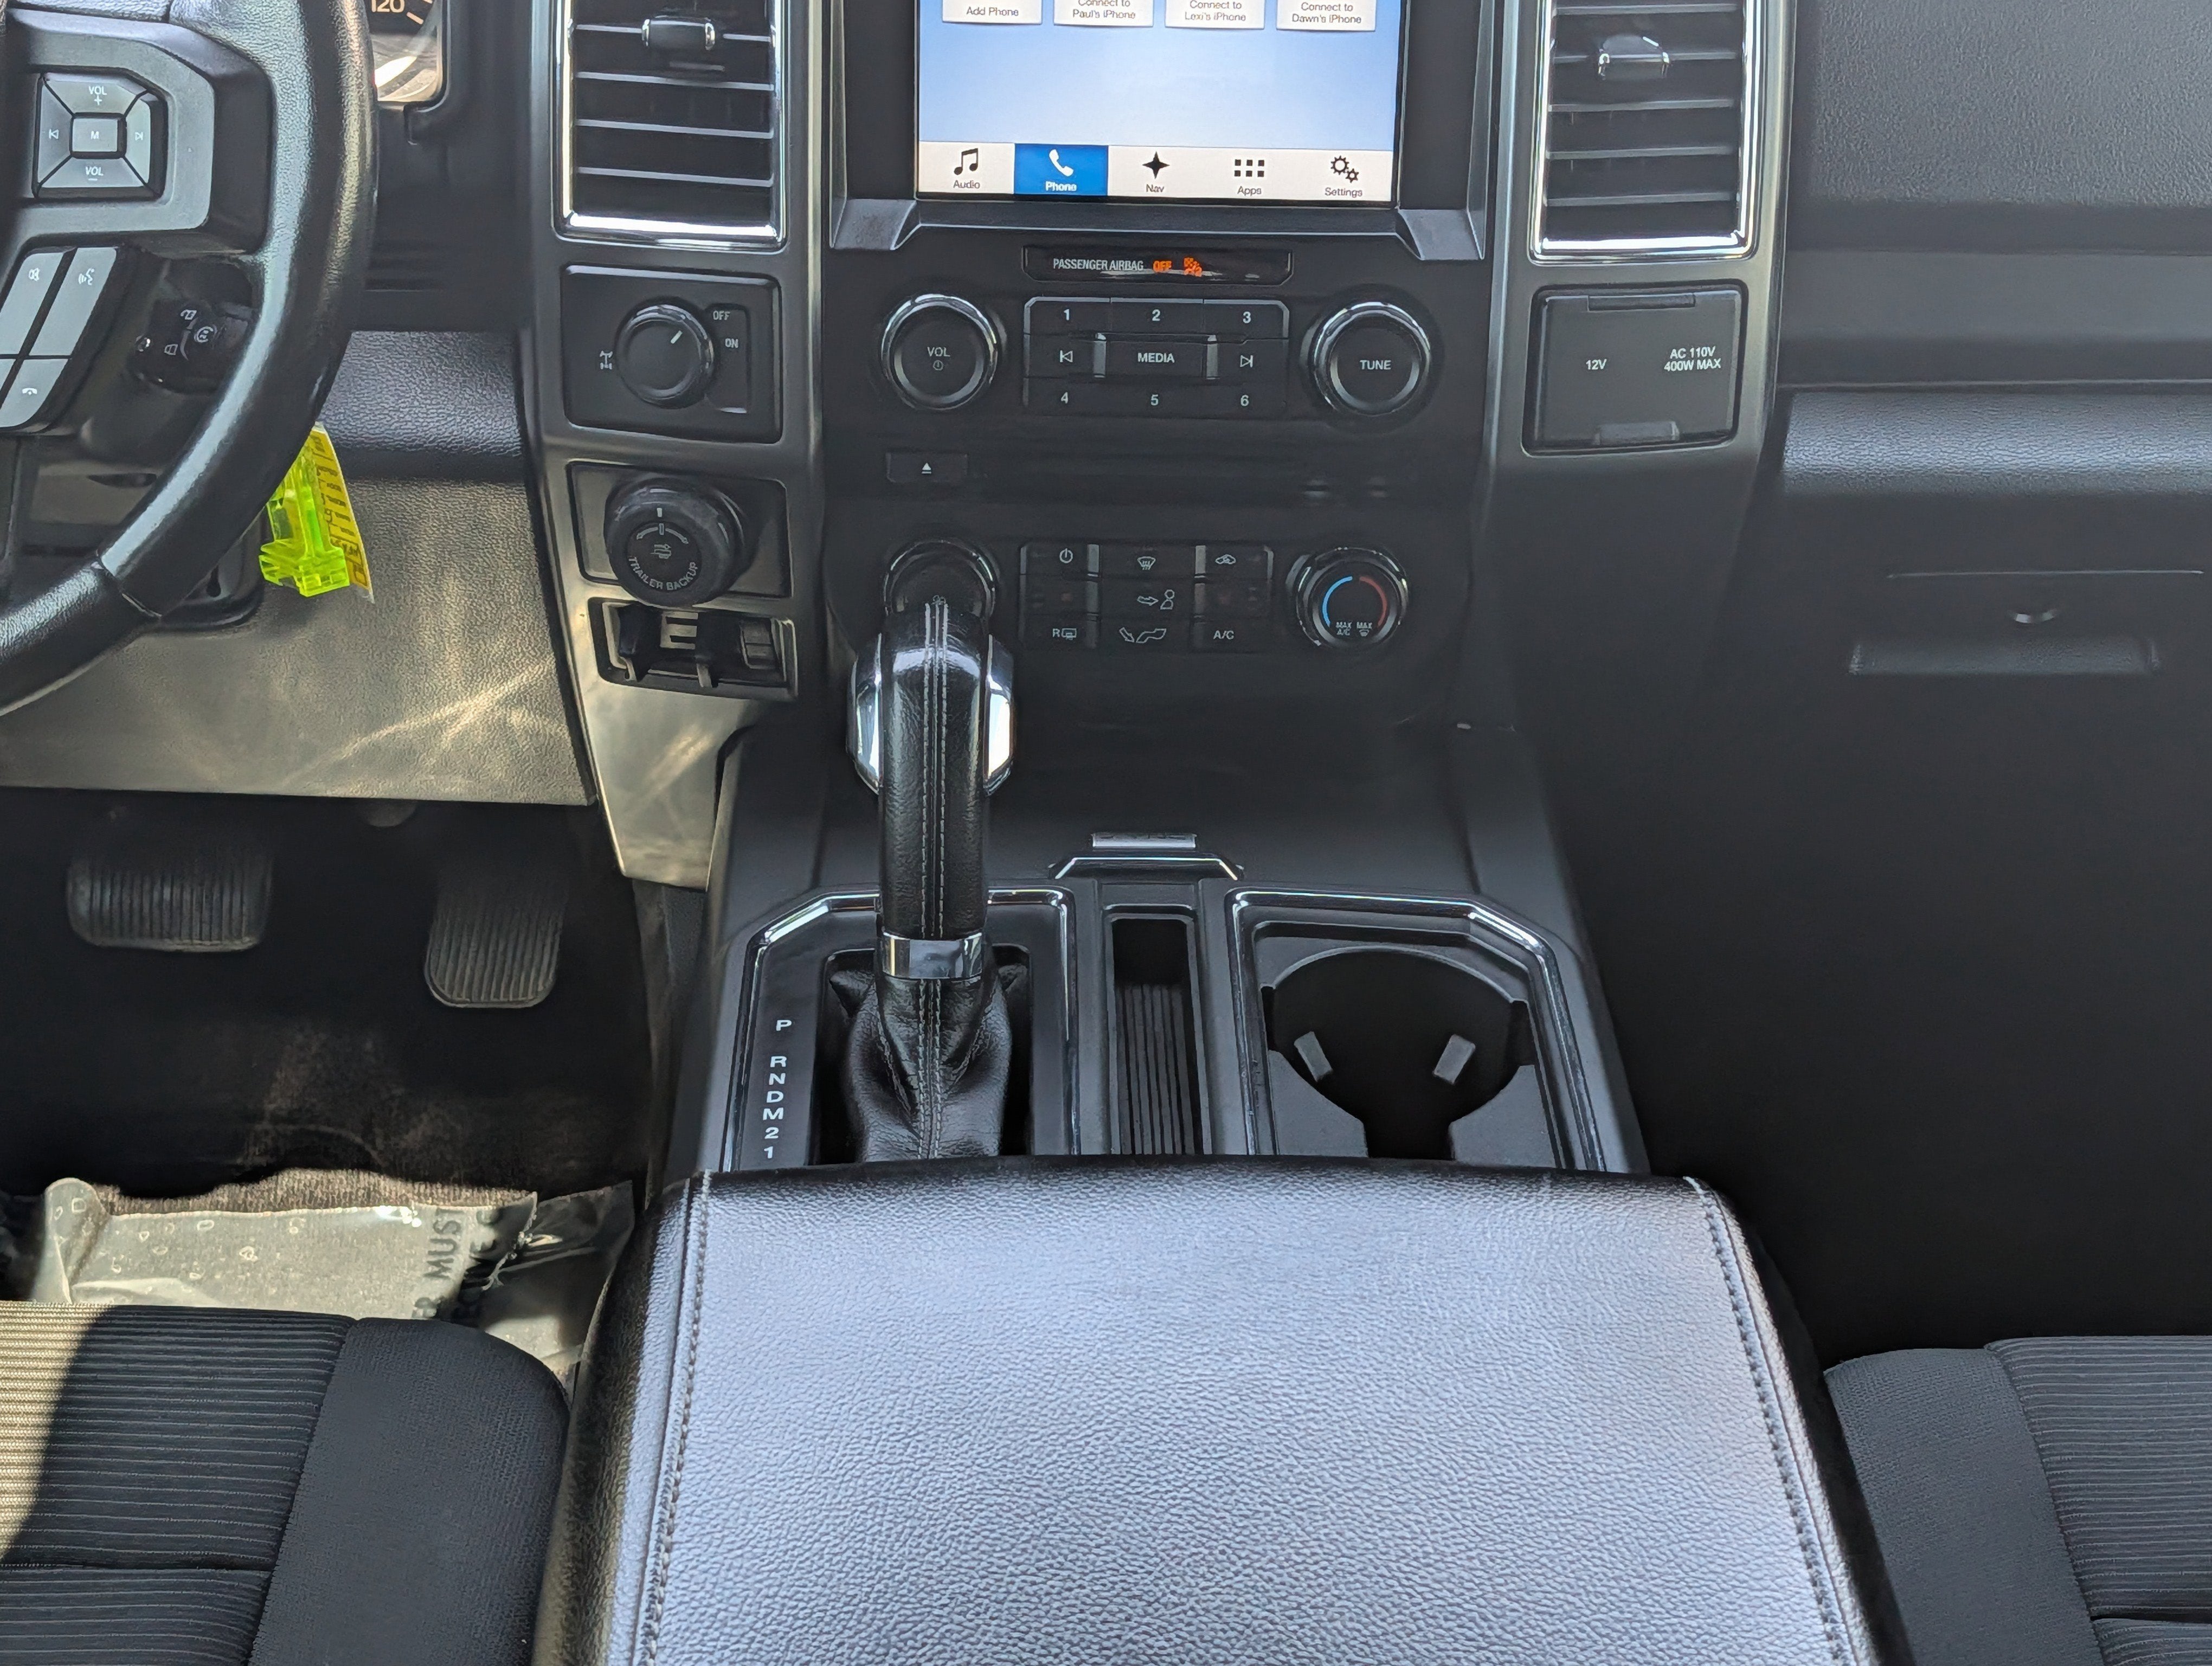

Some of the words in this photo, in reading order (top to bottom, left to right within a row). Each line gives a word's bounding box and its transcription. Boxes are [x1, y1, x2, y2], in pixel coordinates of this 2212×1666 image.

[1189, 0, 1230, 10] Connect
[1232, 1, 1242, 10] to
[1301, 2, 1342, 11] Connect
[1344, 3, 1353, 12] to
[966, 6, 985, 16] Add
[988, 7, 1019, 16] Phone
[1072, 9, 1100, 18] Paul's
[1103, 9, 1136, 19] iPhone
[1213, 12, 1246, 22] iPhone
[1292, 14, 1326, 23] Dawn's
[1328, 15, 1362, 24] iPhone
[88, 86, 107, 95] VOL
[90, 130, 100, 139] M
[85, 166, 104, 176] VOL
[953, 180, 981, 189] Audio
[1045, 181, 1077, 192] Phone
[1146, 183, 1165, 193] Nav
[1237, 185, 1262, 196] Apps
[1324, 187, 1363, 197] Settings
[1053, 258, 1109, 271] PASSENGER
[1109, 260, 1144, 271] AIRBAG
[1153, 260, 1172, 273] OFF
[712, 310, 730, 321] OFF
[1064, 309, 1070, 321] 1
[1152, 309, 1161, 322] 2
[1242, 311, 1251, 324] 3
[725, 338, 739, 348] ON
[927, 346, 951, 357] VOL
[1669, 348, 1687, 359] AC
[1689, 345, 1716, 358] 110V
[1137, 353, 1175, 363] MEDIA
[1359, 360, 1392, 370] TUNE
[1585, 358, 1607, 370] 12V
[1663, 360, 1693, 371] 400W
[1696, 358, 1721, 370] MAX
[1060, 392, 1069, 403] 4
[1150, 394, 1159, 406] 5
[1240, 395, 1249, 406] 6
[628, 556, 663, 590] TRAILER
[666, 562, 698, 591] BACKUP
[1052, 629, 1060, 638] R
[1213, 630, 1234, 640] A/C
[775, 1019, 792, 1031] P
[769, 1055, 787, 1068] R
[768, 1073, 786, 1085] N
[766, 1090, 784, 1103] D
[762, 1107, 784, 1120] M
[764, 1126, 780, 1139] 2
[763, 1146, 774, 1159] 1
[423, 1207, 465, 1279] MUST
